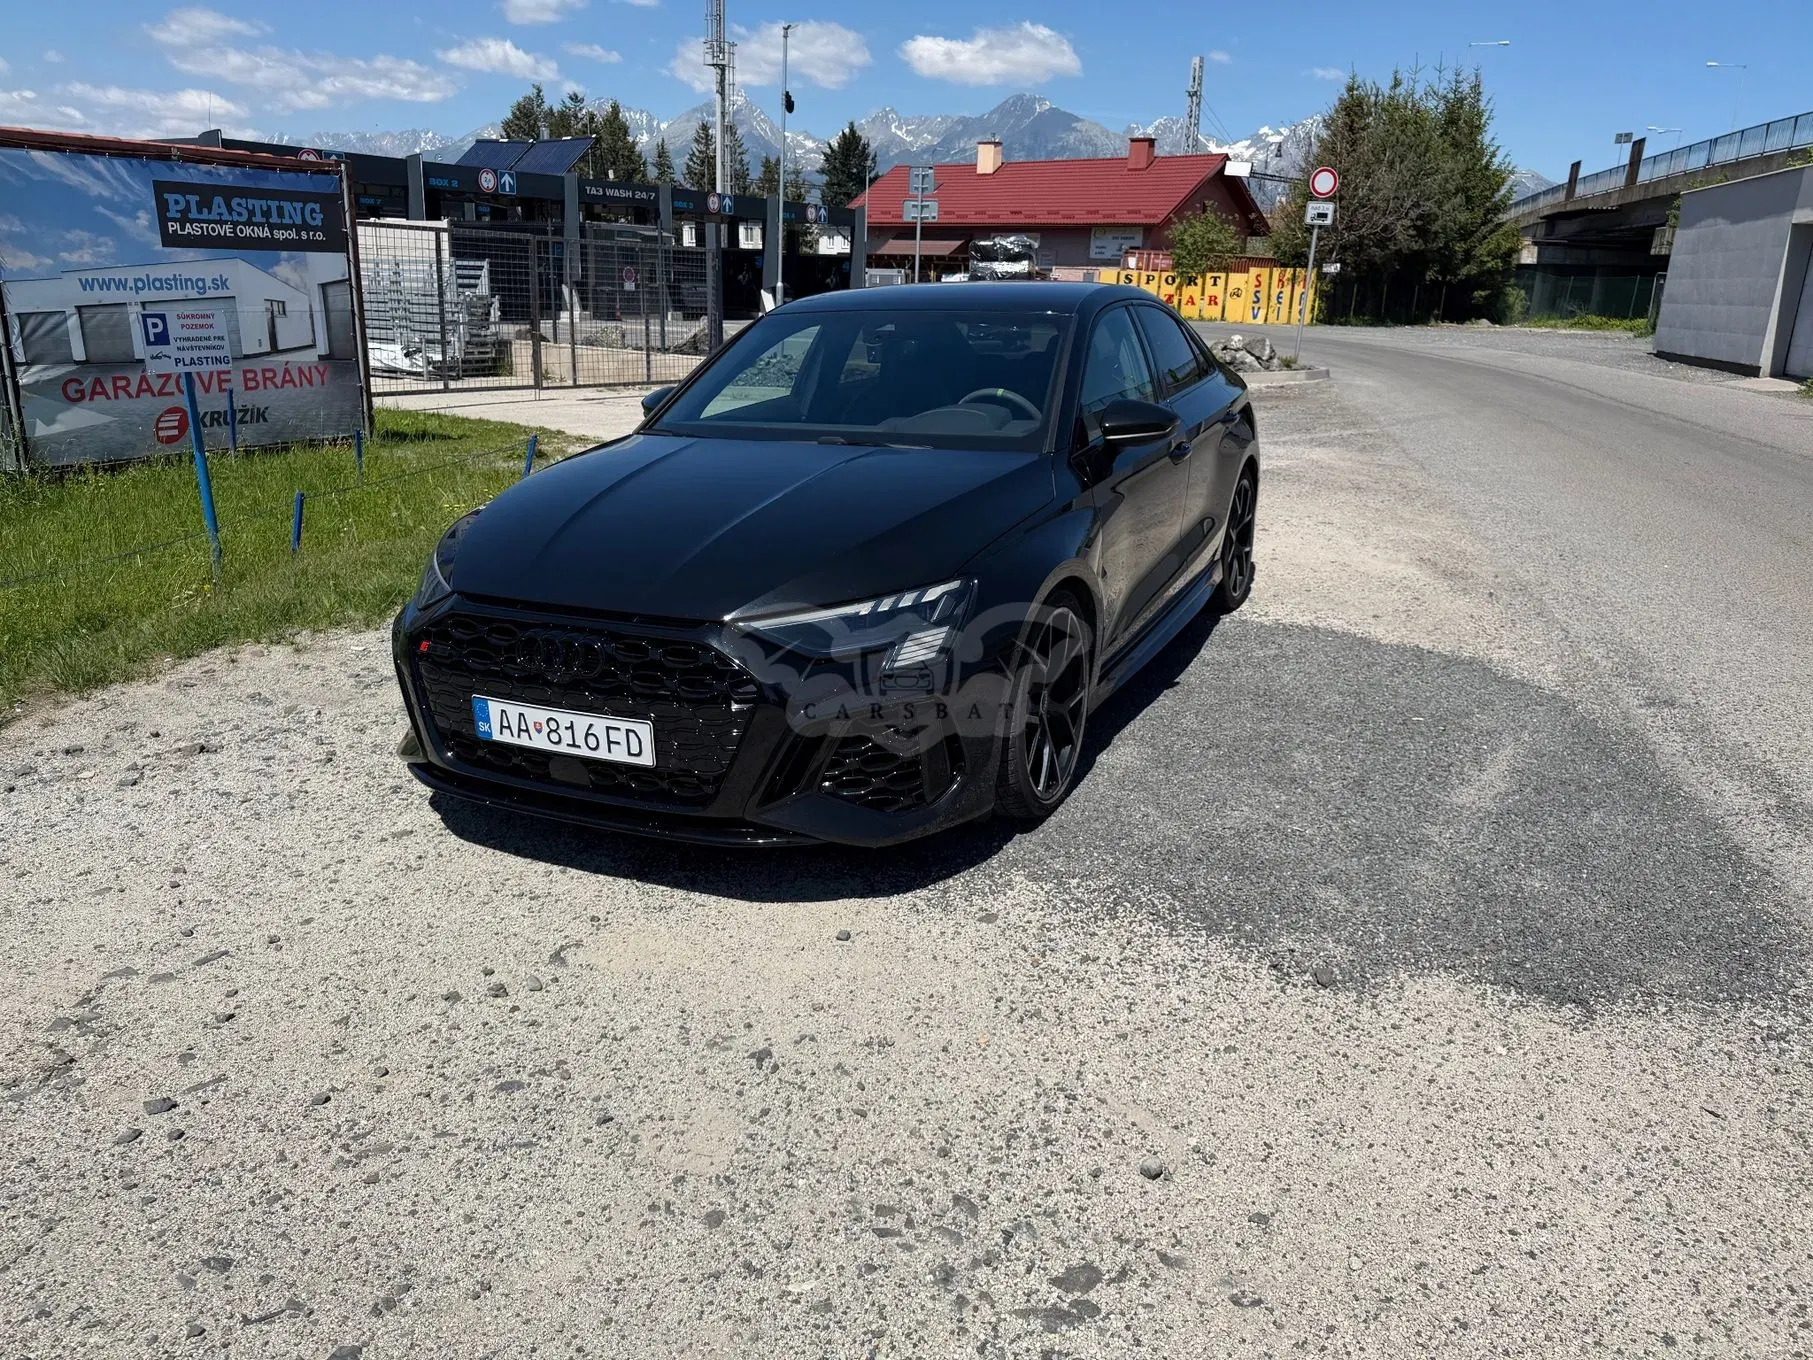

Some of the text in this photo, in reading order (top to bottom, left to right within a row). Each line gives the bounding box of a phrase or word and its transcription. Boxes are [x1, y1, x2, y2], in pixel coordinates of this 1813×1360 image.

[429, 178, 448, 187] BOX
[585, 186, 656, 200] TA3 WASH 24/7
[163, 193, 324, 227] PLASTING
[167, 221, 326, 241] PLASTOVÉ OKNÁ spol. s r.o.
[78, 273, 230, 295] www.plasting.sk
[1123, 273, 1221, 287] SPORT
[1164, 293, 1219, 306] ZAR
[174, 355, 231, 367] PLASTING
[242, 362, 330, 392] BRÁNY
[478, 721, 491, 733] SK
